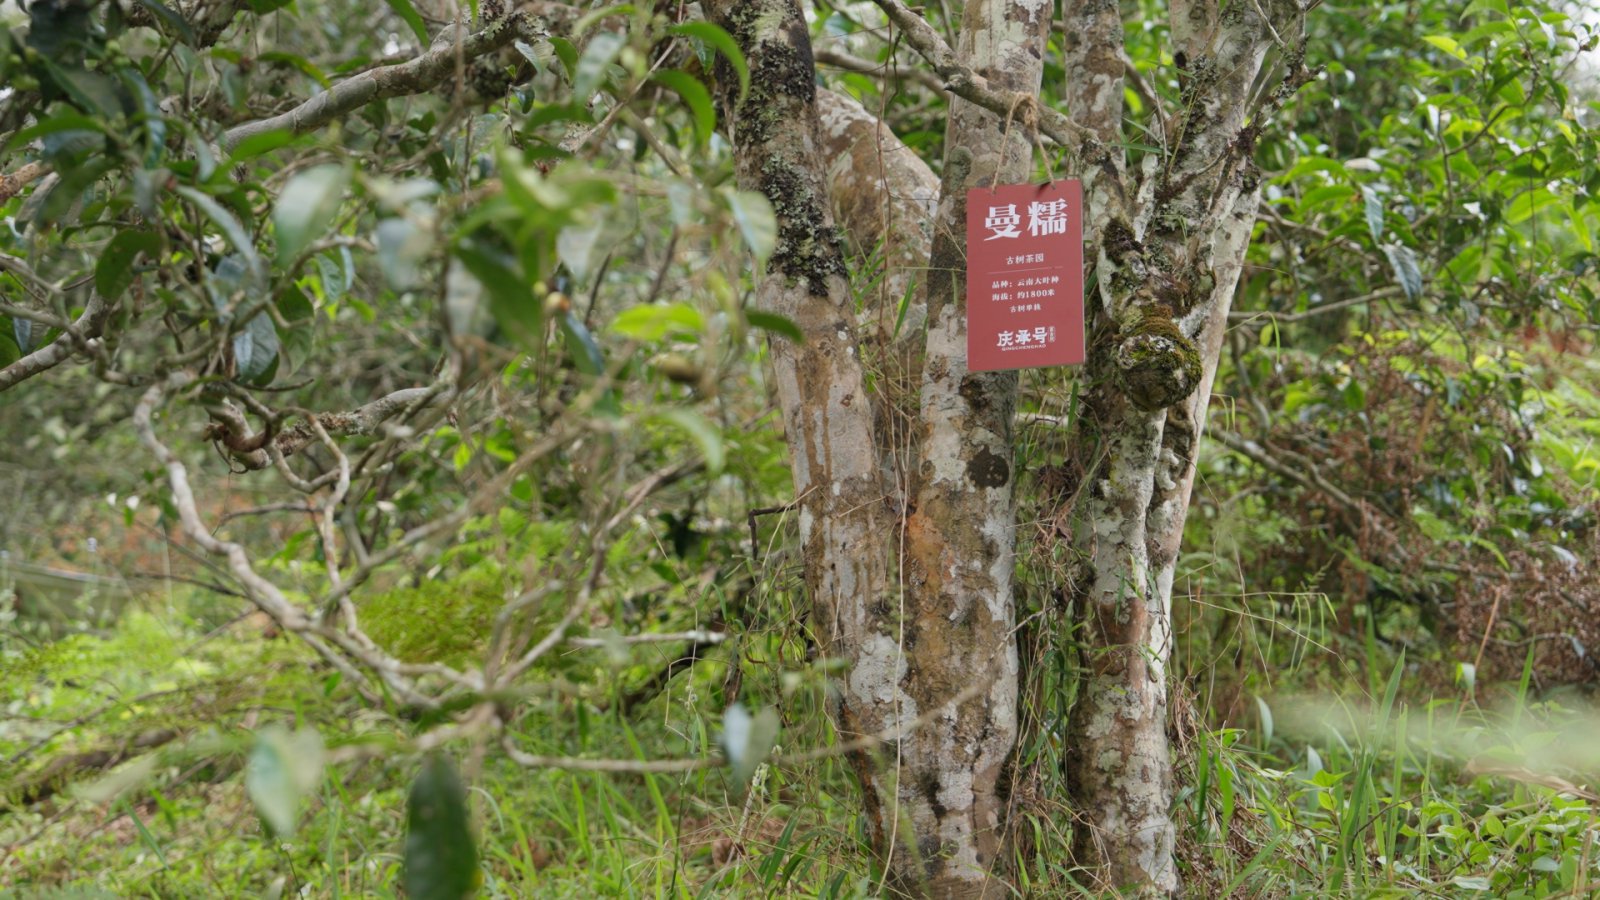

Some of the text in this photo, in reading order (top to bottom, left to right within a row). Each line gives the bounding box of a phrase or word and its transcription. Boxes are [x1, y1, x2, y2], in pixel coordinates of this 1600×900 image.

[984, 199, 1068, 242] 曼糯
[1005, 253, 1044, 265] 古树茶园
[997, 326, 1047, 347] 庆承号
